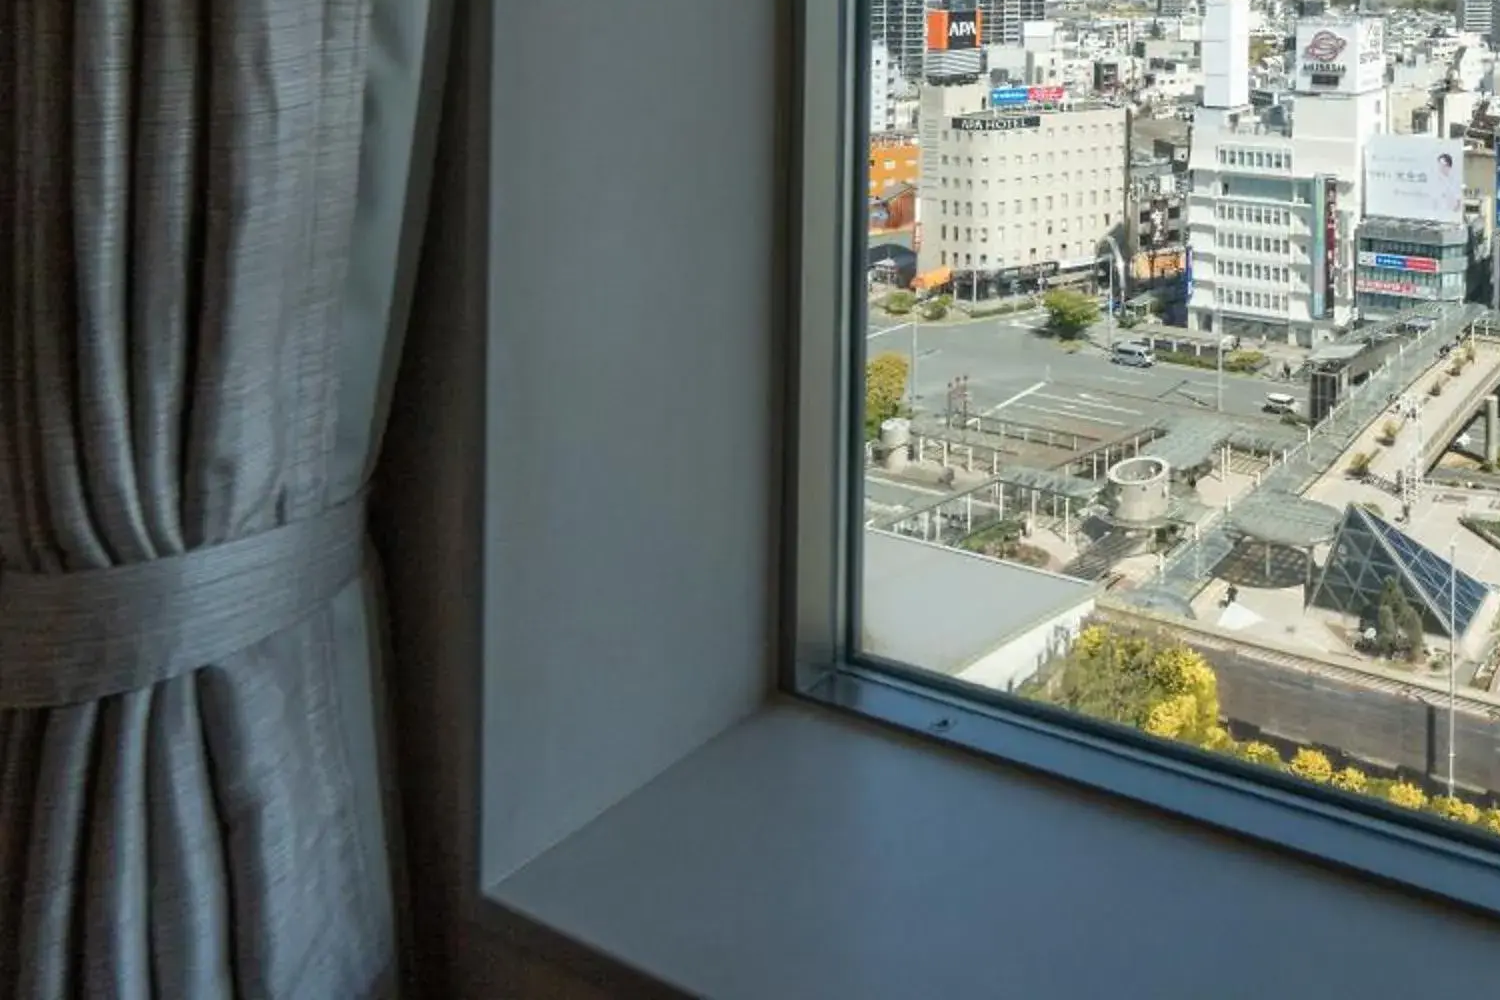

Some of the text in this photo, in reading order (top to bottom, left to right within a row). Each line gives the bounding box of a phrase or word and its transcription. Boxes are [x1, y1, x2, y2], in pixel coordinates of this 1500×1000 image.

[949, 21, 976, 36] APA
[961, 117, 1026, 130] APA HOTEL
